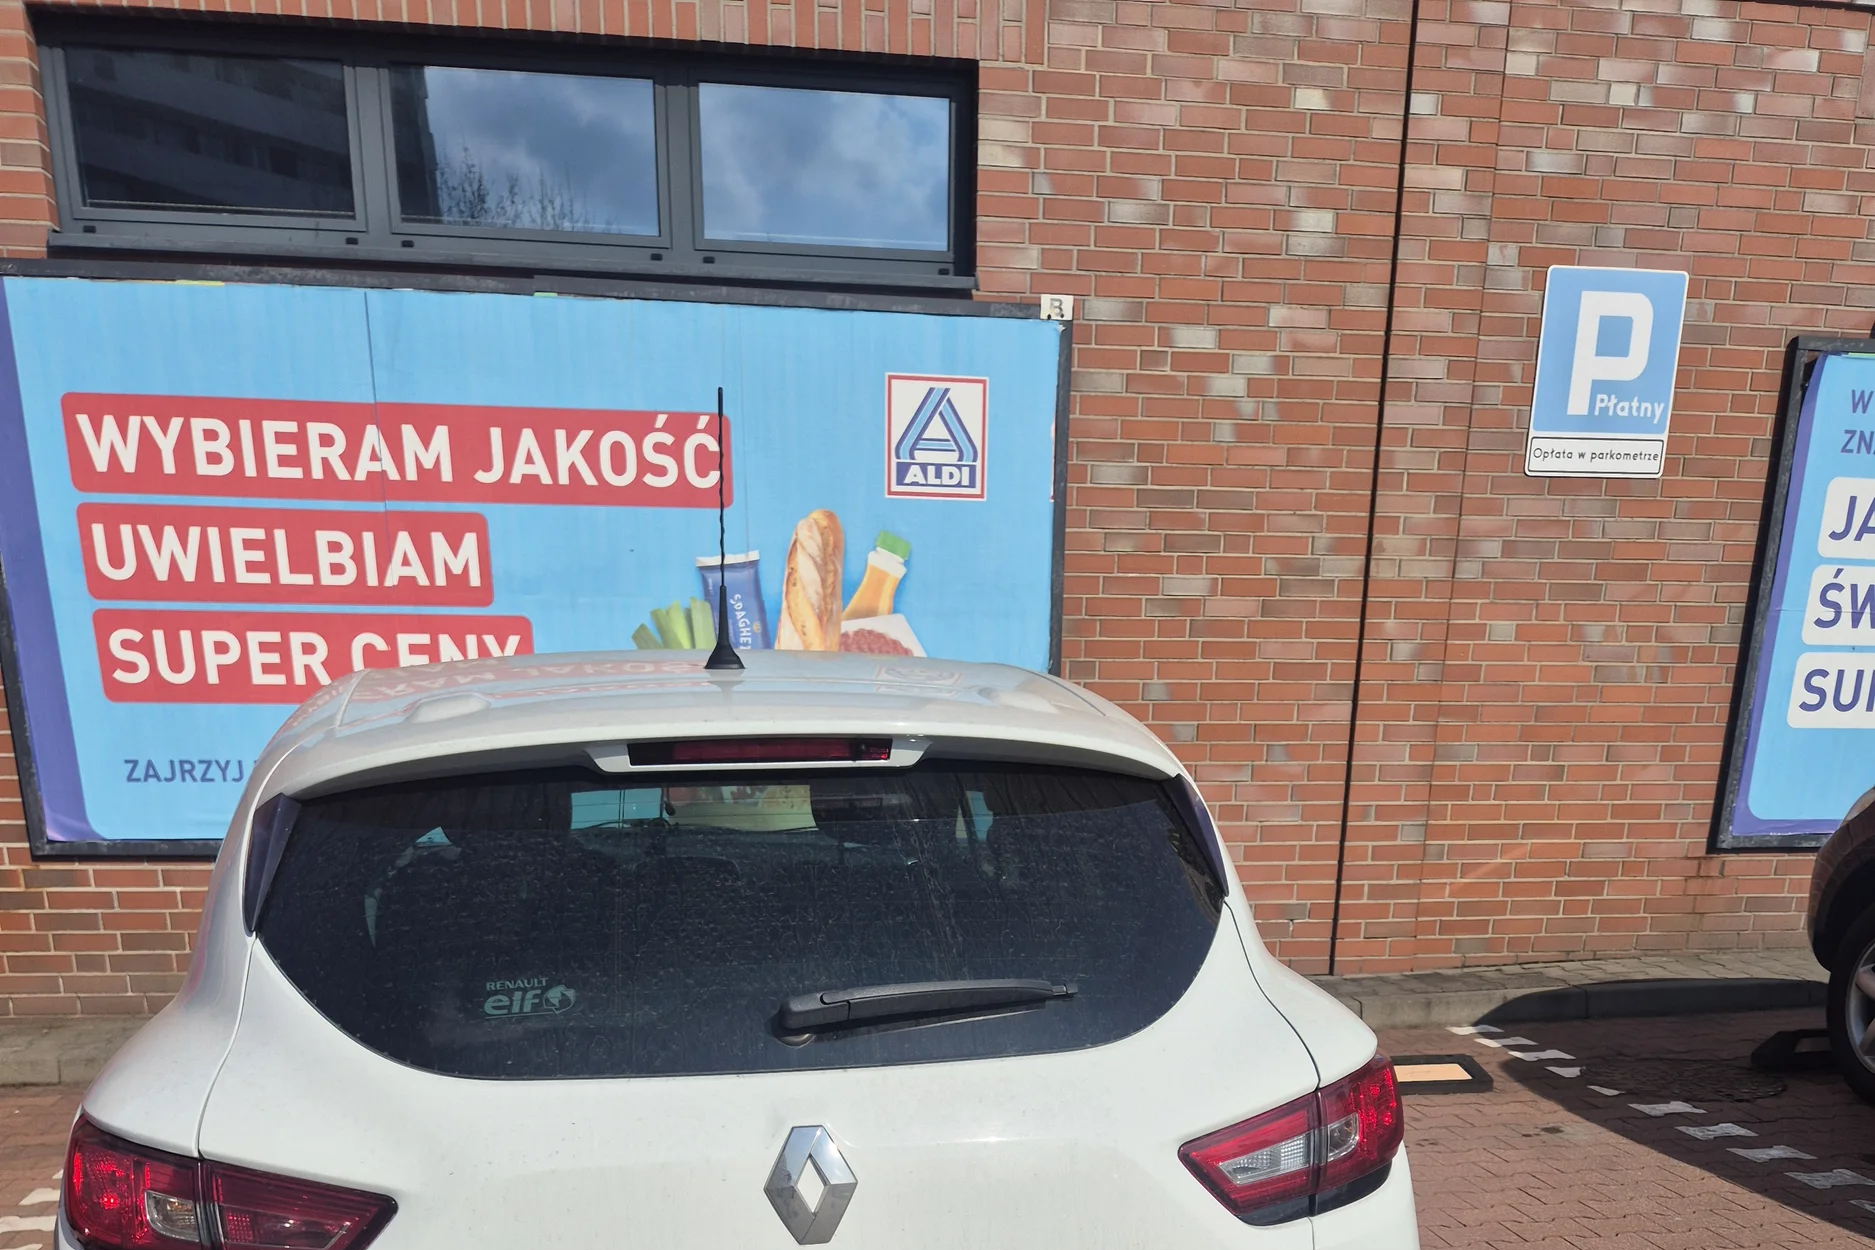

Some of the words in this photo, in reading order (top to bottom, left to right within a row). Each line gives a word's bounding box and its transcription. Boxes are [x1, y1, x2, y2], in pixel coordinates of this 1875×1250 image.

[1567, 291, 1654, 416] P
[1594, 393, 1665, 425] Płatny
[76, 413, 453, 483] WYBIERAM
[474, 413, 721, 489] JAKOŚĆ
[1533, 447, 1573, 462] Opłata
[1578, 451, 1586, 460] w
[1590, 449, 1659, 463] parkometrze
[1840, 429, 1875, 455] ZN
[903, 464, 970, 486] ALDI
[92, 522, 482, 587] UWIELBIAM
[109, 628, 332, 686] SUPER
[124, 759, 244, 783] ZAJRZYJ
[486, 977, 549, 991] RENAULT
[484, 989, 541, 1015] elf
